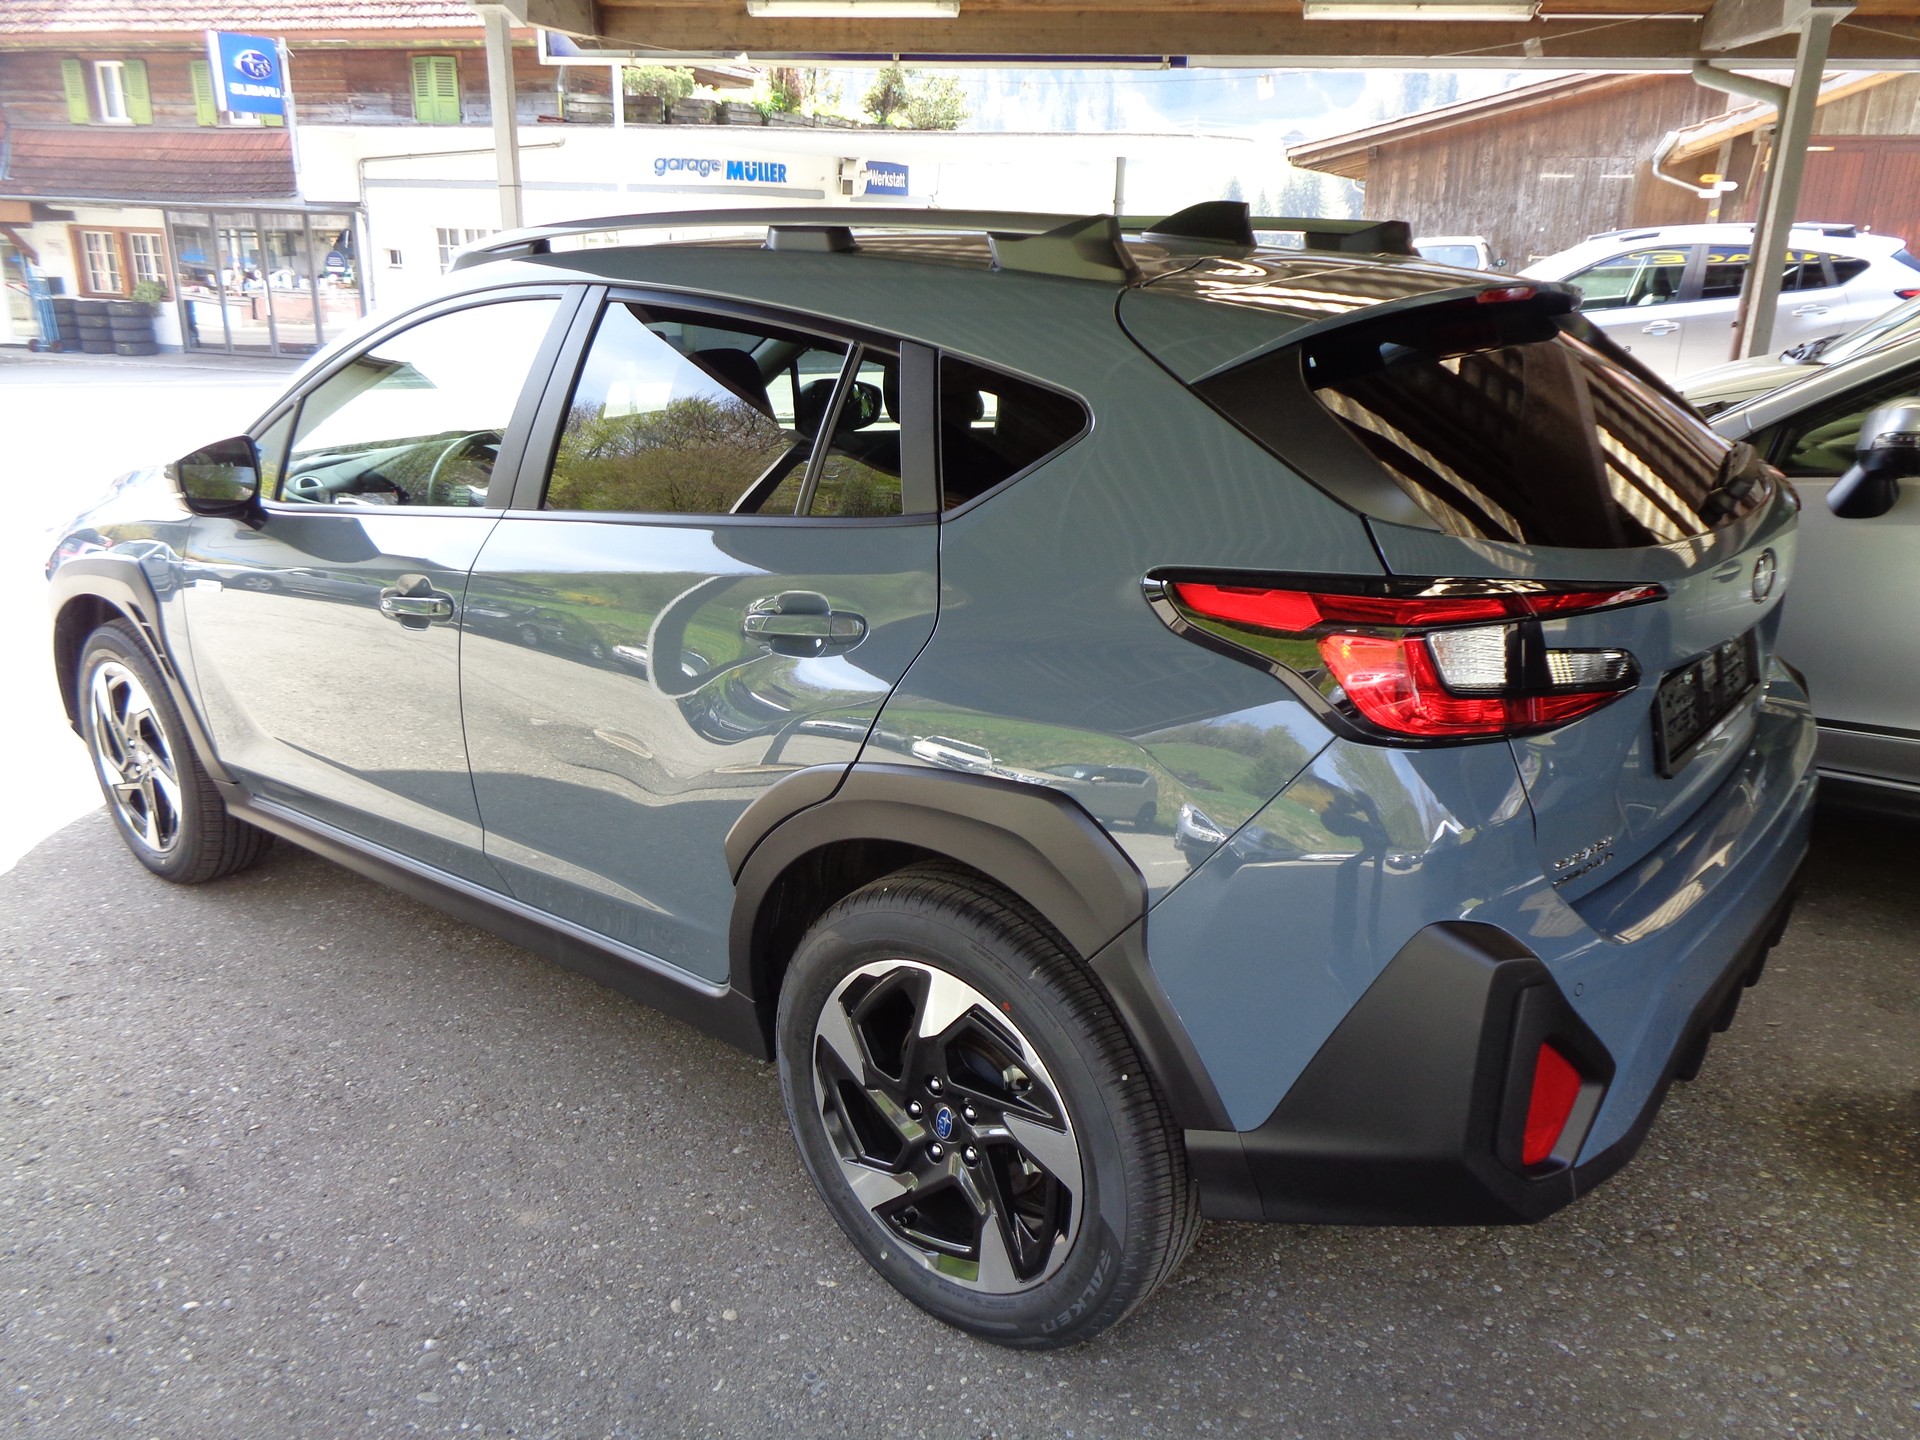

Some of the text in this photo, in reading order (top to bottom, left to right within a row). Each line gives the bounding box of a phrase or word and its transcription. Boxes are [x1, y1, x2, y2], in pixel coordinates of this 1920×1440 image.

[654, 157, 787, 183] garage MÜLLER
[870, 168, 906, 188] Werkstatt
[1041, 1248, 1112, 1334] FALKEN
